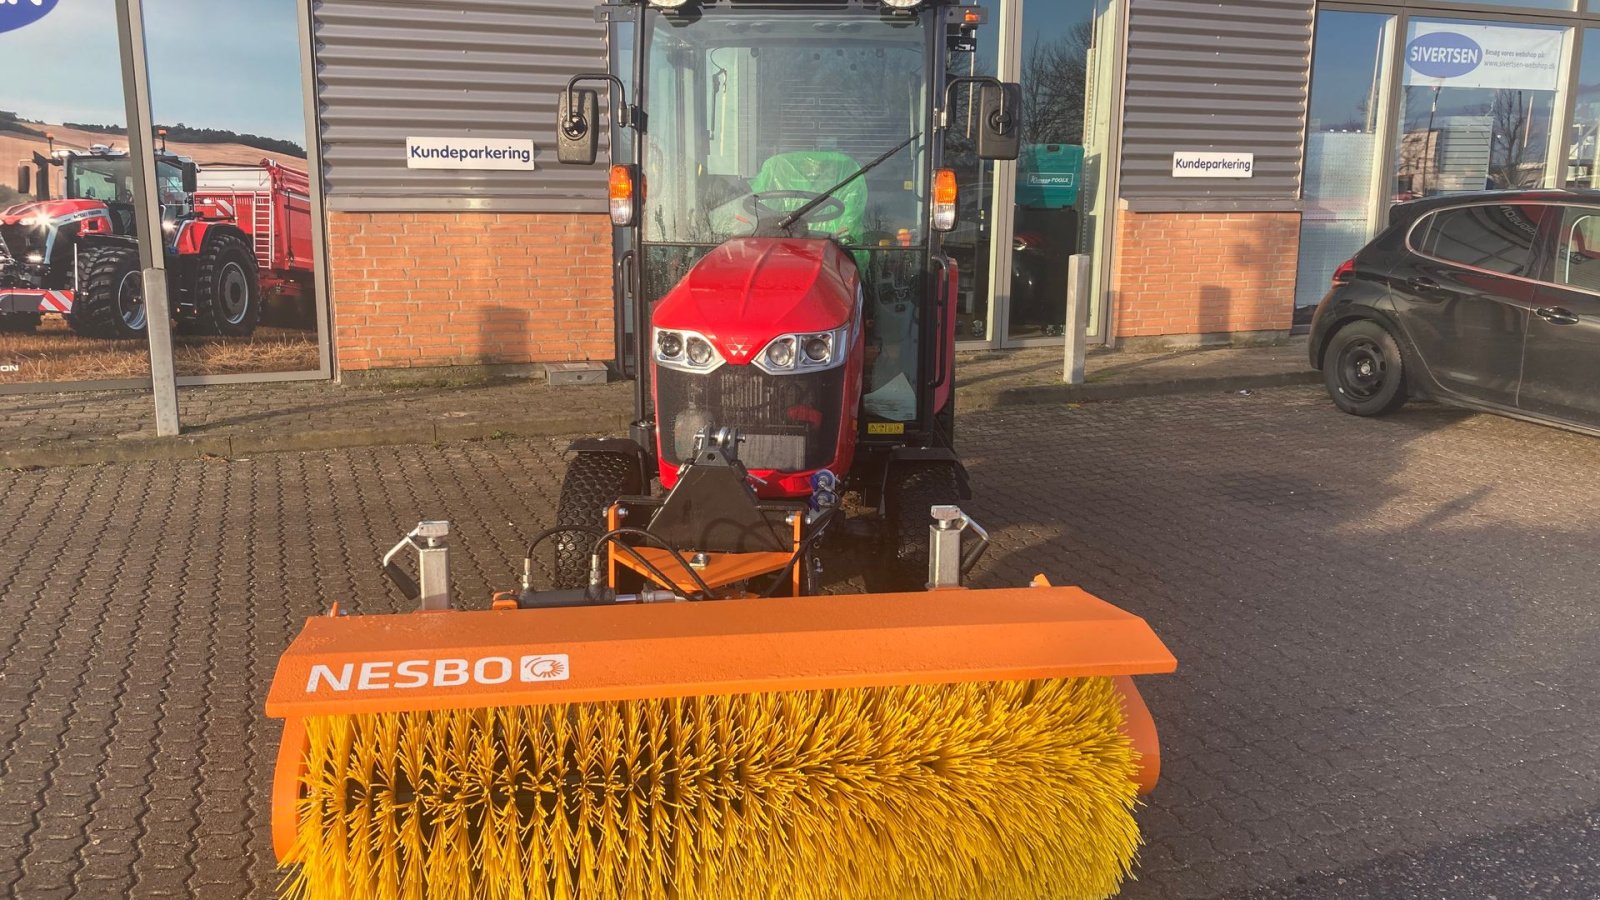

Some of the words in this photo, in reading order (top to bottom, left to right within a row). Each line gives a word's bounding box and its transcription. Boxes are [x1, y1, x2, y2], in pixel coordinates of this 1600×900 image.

[1410, 46, 1478, 64] SIVERTSEN
[410, 145, 530, 163] Kundeparkering
[1175, 158, 1251, 172] Kundeparkering
[305, 657, 513, 693] NESBO
